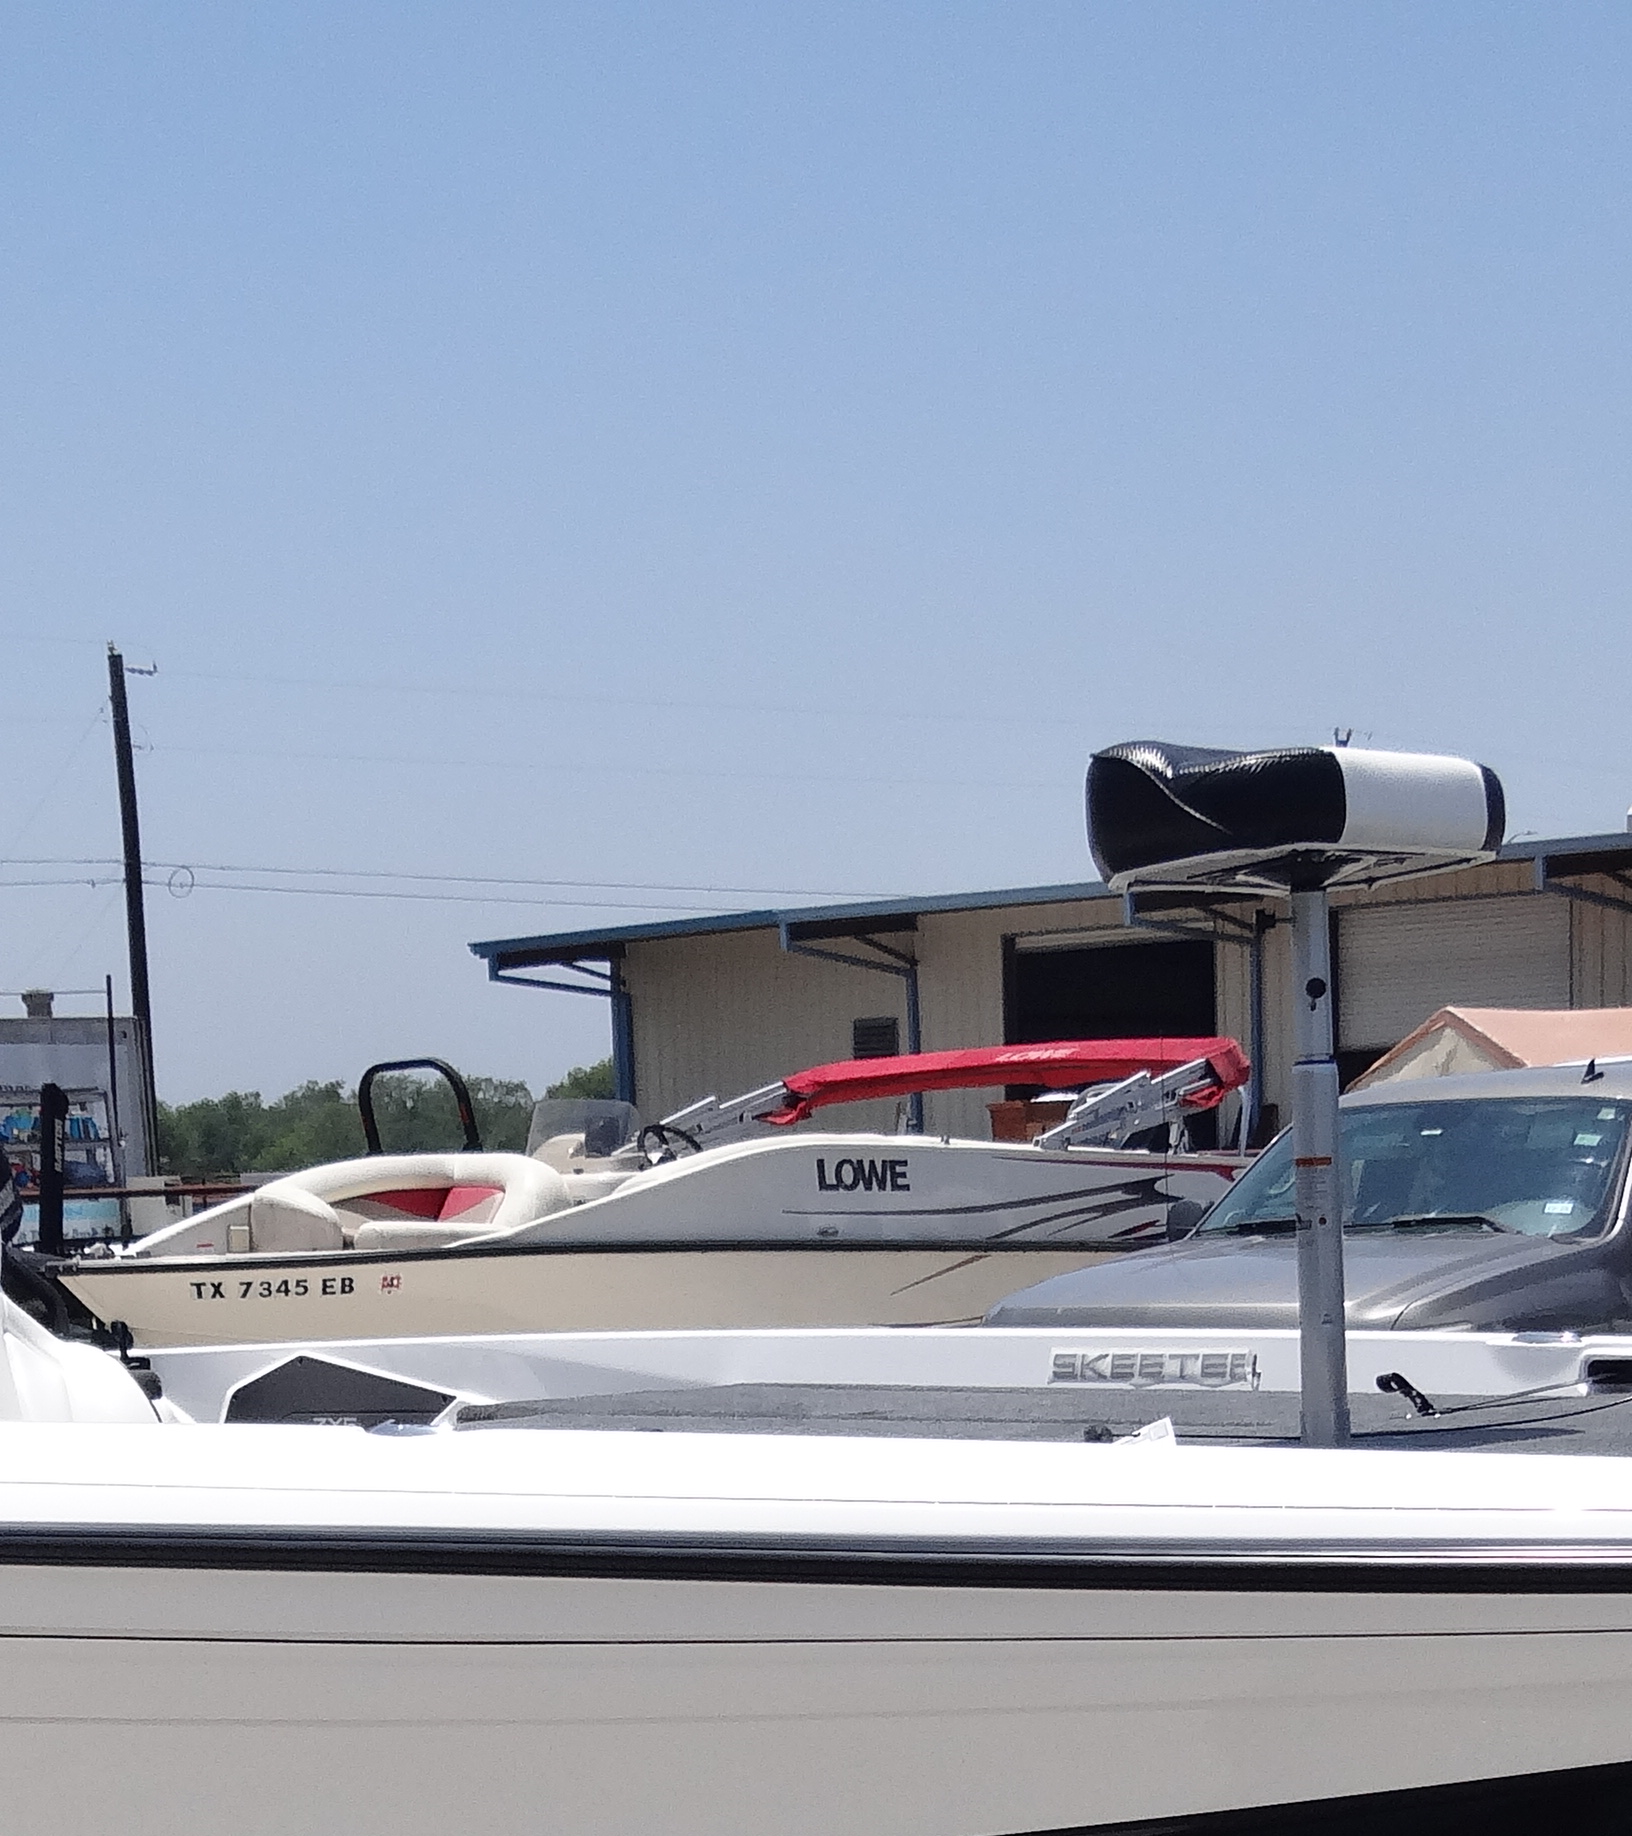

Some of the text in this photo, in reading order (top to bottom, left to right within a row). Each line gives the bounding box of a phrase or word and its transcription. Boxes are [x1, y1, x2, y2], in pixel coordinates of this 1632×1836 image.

[816, 1158, 911, 1192] LOWE
[190, 1276, 355, 1299] TX 7345 EB
